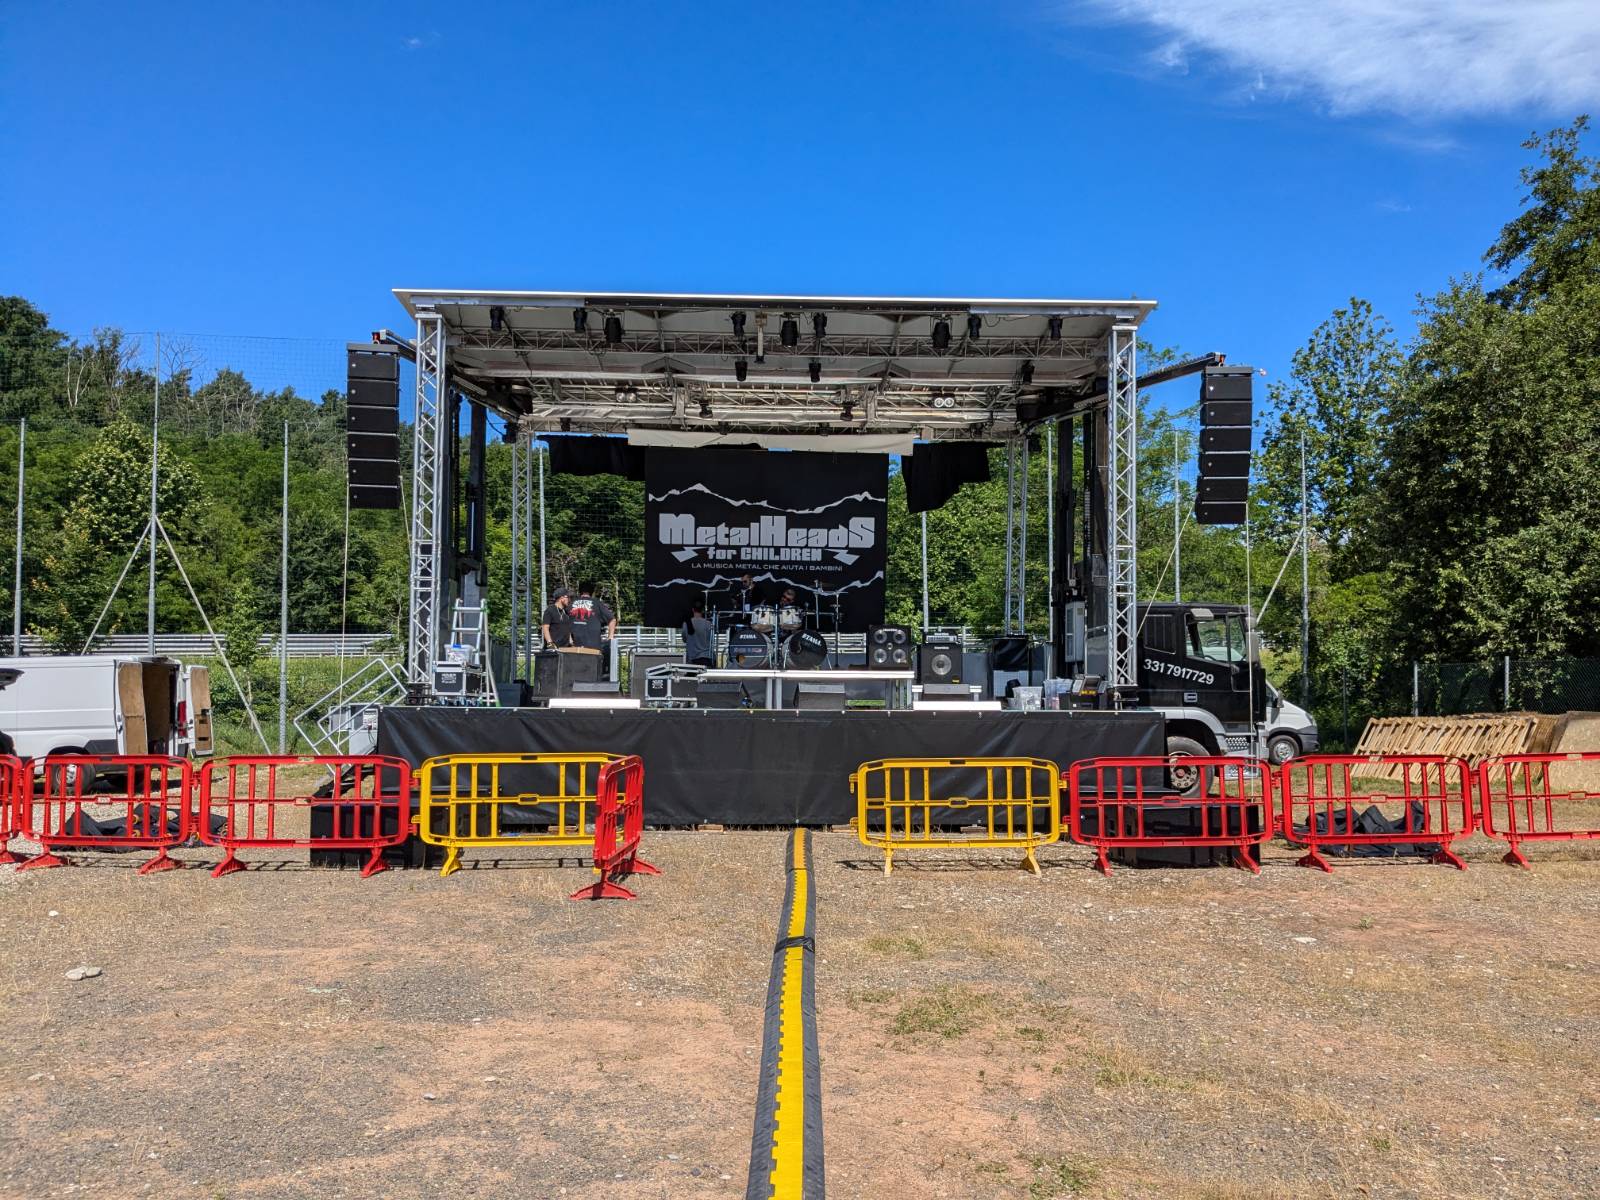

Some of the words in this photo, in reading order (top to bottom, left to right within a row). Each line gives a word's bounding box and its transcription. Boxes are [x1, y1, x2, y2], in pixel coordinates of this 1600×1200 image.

[706, 546, 737, 560] for
[740, 547, 822, 561] CHILDREN
[805, 634, 822, 646] TAMA
